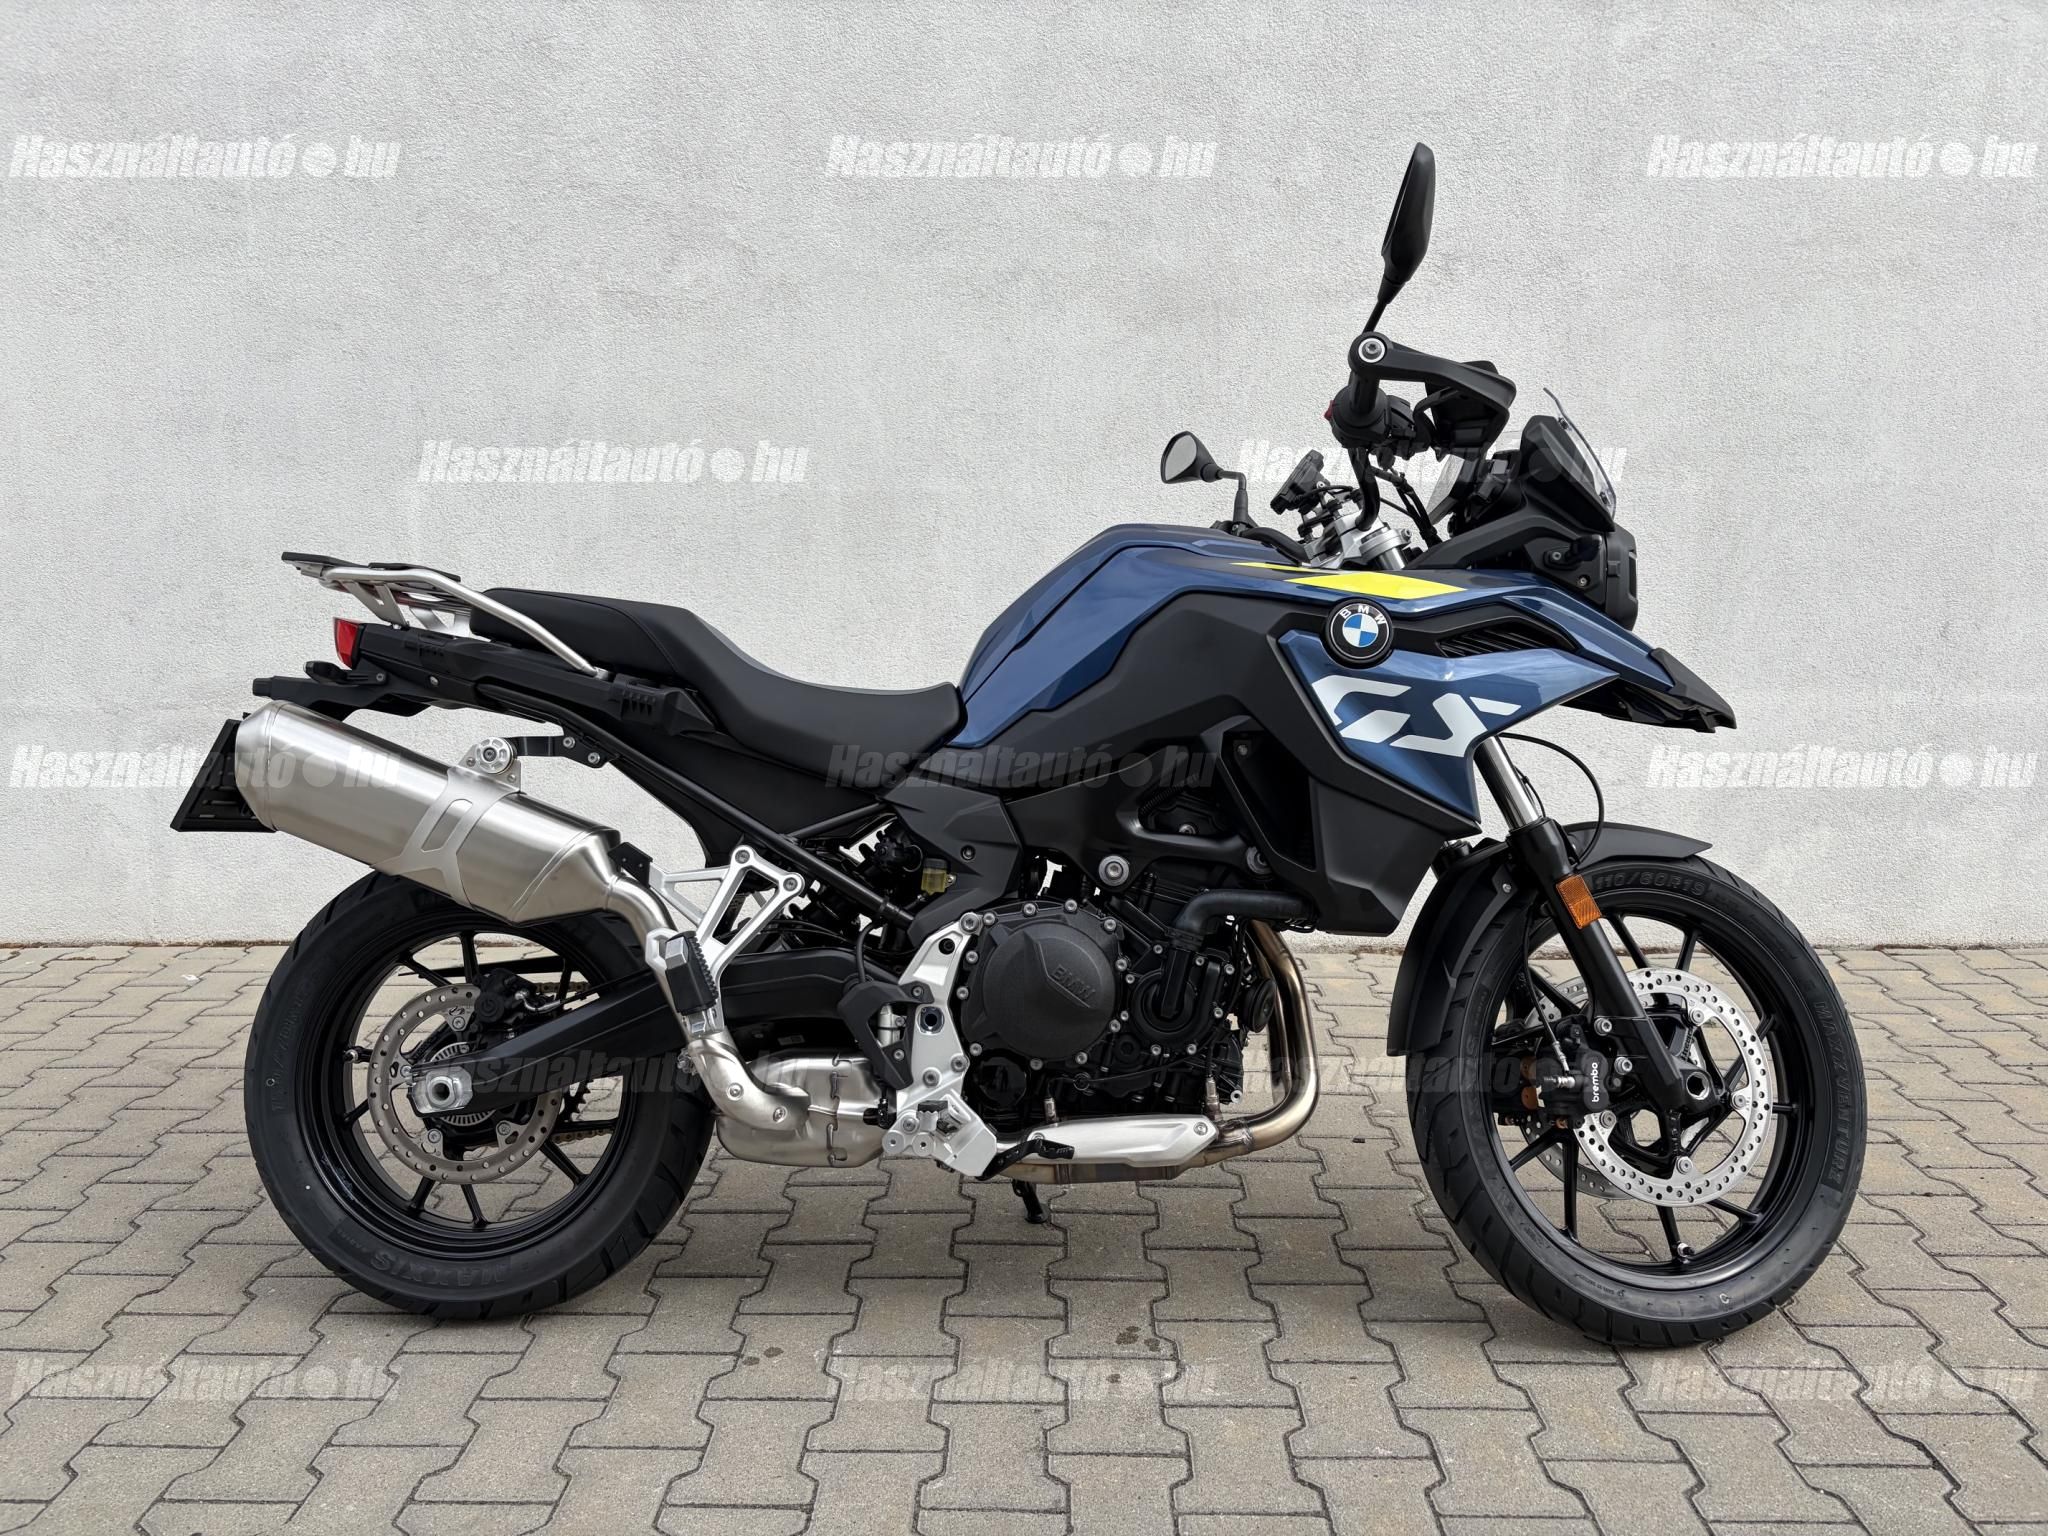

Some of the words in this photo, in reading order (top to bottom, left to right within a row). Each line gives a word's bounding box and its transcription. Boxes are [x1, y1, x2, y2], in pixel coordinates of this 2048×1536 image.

[1340, 604, 1387, 625] BMW
[1311, 674, 1522, 758] GS
[1051, 963, 1096, 1000] BMW
[1590, 1062, 1600, 1103] brembo
